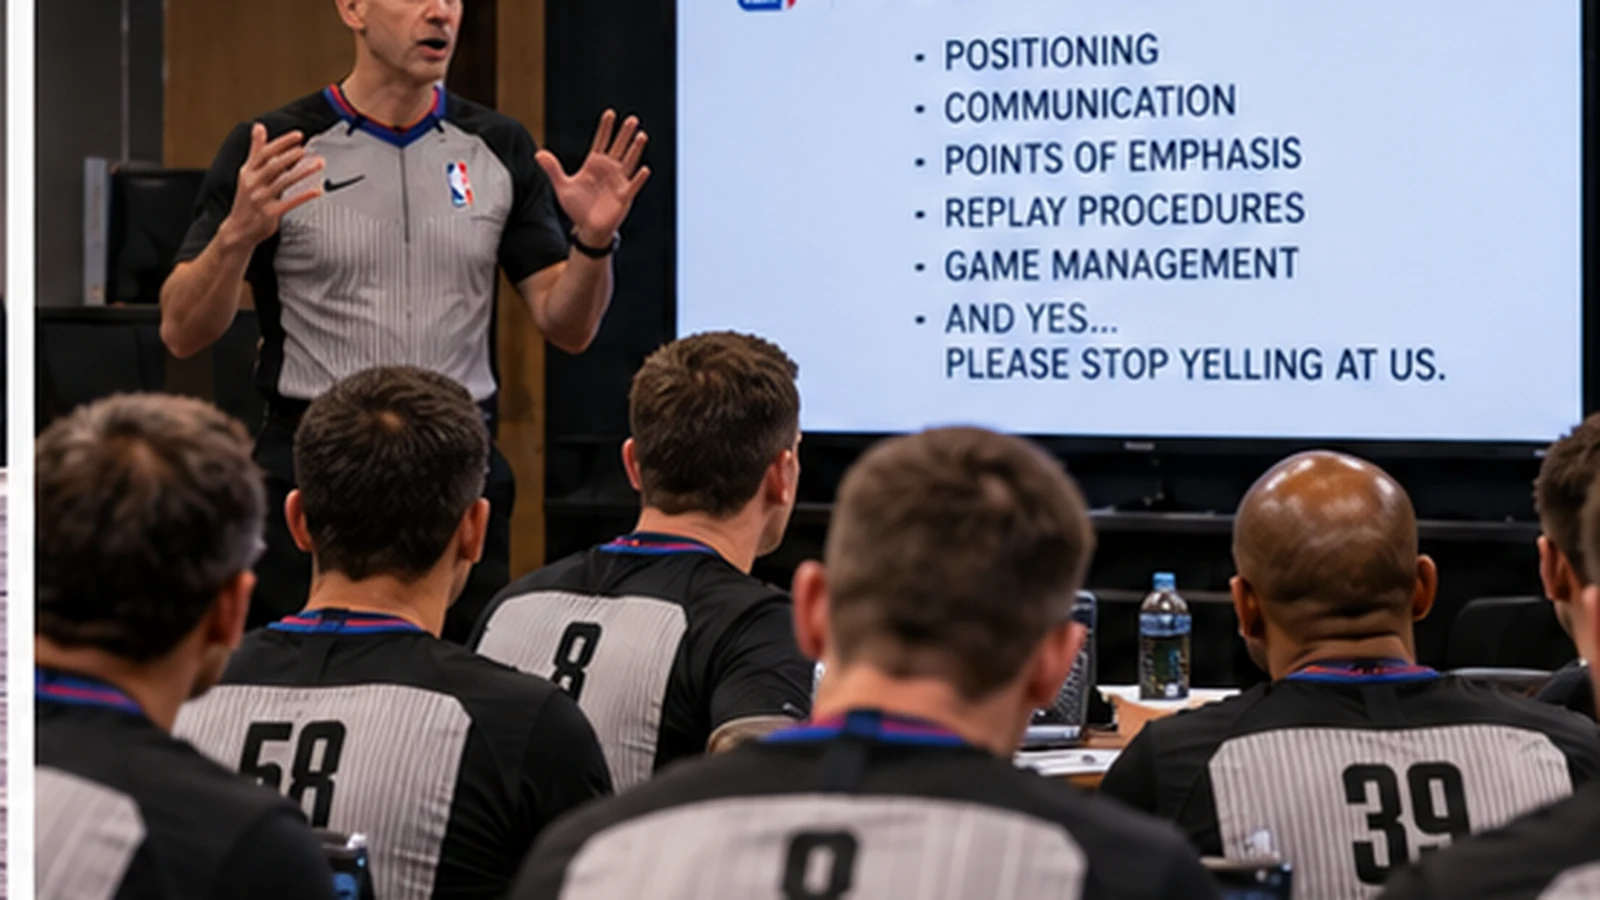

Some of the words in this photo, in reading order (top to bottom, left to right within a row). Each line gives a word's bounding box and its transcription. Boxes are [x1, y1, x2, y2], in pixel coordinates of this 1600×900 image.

[945, 33, 1159, 71] POSITIONING
[945, 84, 1236, 124] COMMUNICATION
[945, 141, 1064, 176] POINTS
[1074, 140, 1117, 174] OF
[1129, 136, 1302, 173] EMPHASIS
[945, 196, 1067, 228] REPLAY
[1078, 191, 1305, 227] PROCEDURES
[945, 248, 1040, 282] GAME
[1052, 246, 1299, 281] MANAGEMENT
[945, 303, 1015, 334] AND
[1026, 302, 1117, 334] YES...
[945, 347, 1069, 380] PLEASE
[1081, 347, 1169, 380] STOP
[1179, 347, 1323, 381] YELLING
[1335, 348, 1378, 381] AT
[1390, 347, 1446, 382] US.
[551, 621, 603, 703] 8
[239, 719, 347, 828] 58
[1342, 761, 1472, 886] 39
